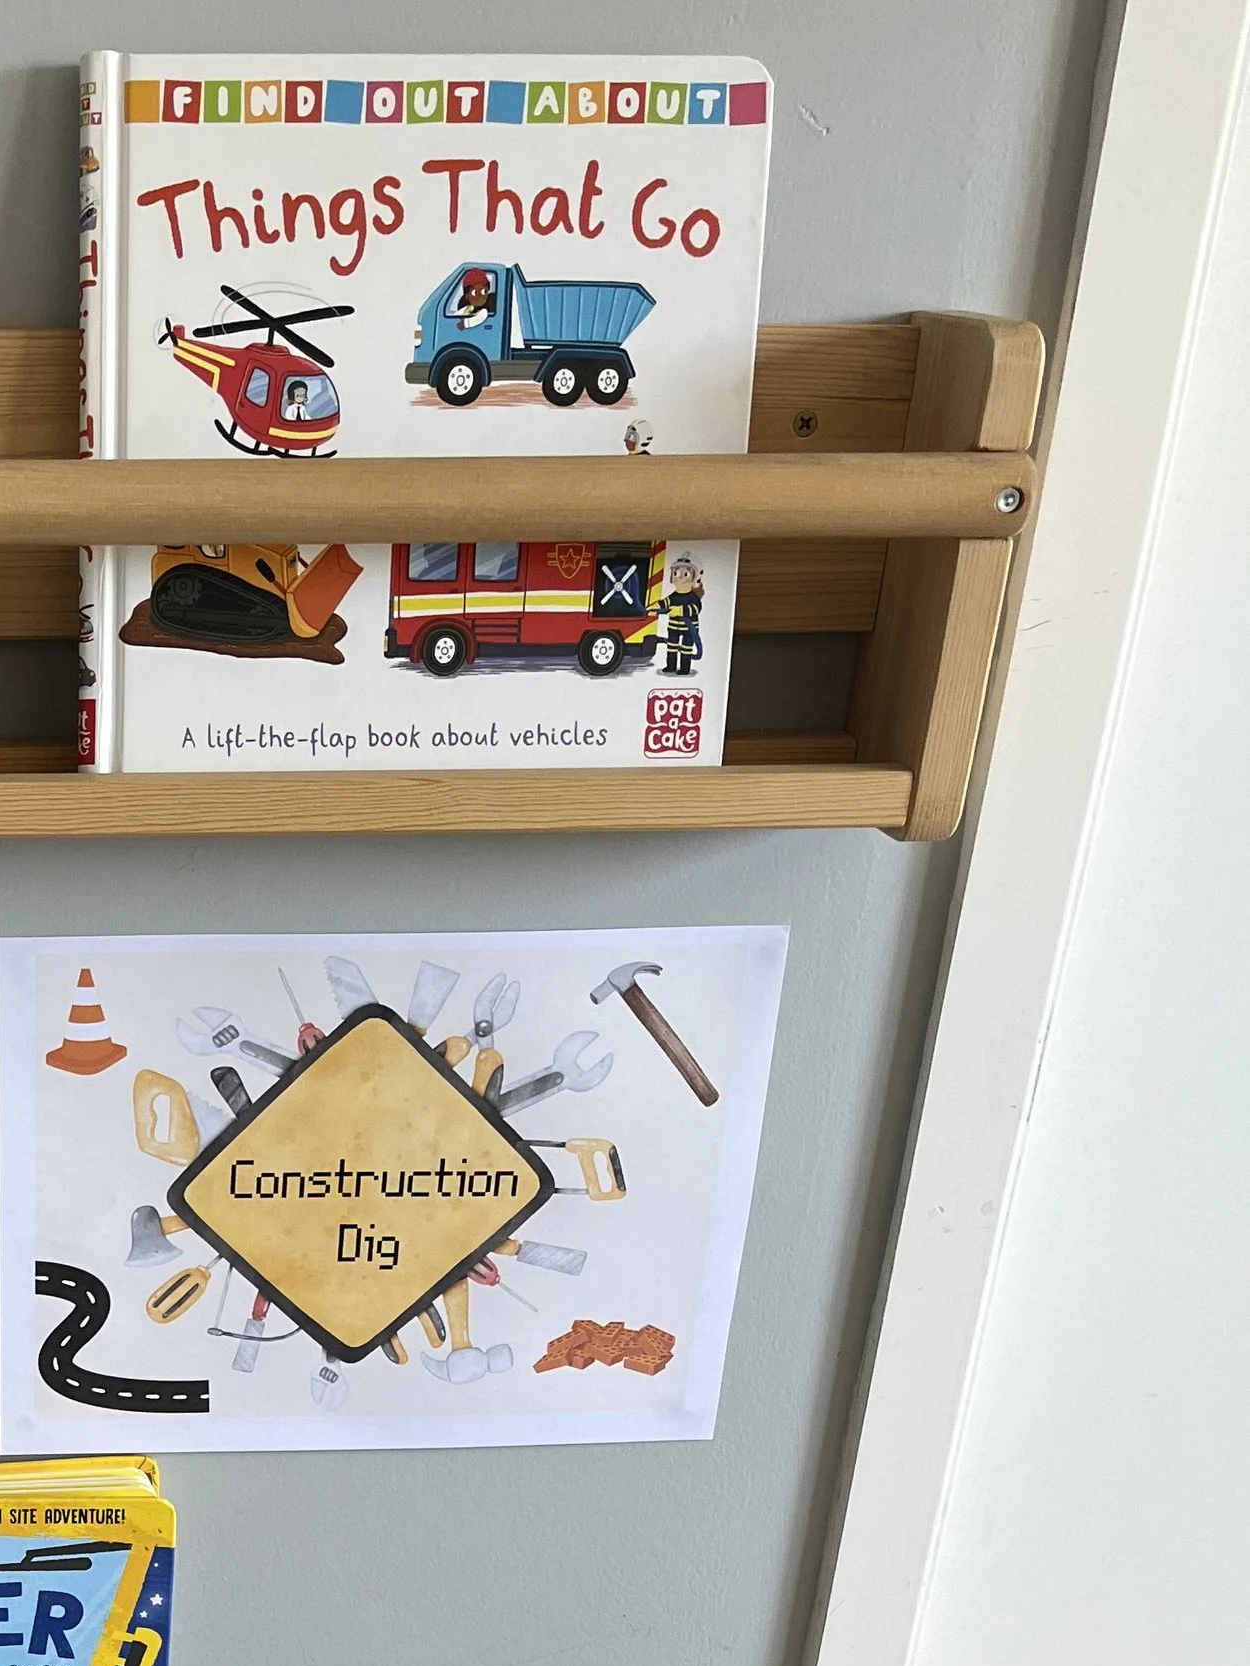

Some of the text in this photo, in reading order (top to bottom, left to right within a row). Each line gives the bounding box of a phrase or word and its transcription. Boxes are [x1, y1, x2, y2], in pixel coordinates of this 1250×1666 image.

[171, 84, 722, 119] FIND OUT ABOUT
[137, 158, 721, 277] Things That Go
[653, 697, 697, 722] pat
[668, 717, 679, 730] a
[181, 719, 608, 758] A lift-the-flap book about vehicles
[229, 1158, 519, 1200] Construction
[337, 1223, 401, 1270] Dig
[9, 1508, 37, 1525] SITE
[44, 1508, 127, 1525] ADVENTURE!
